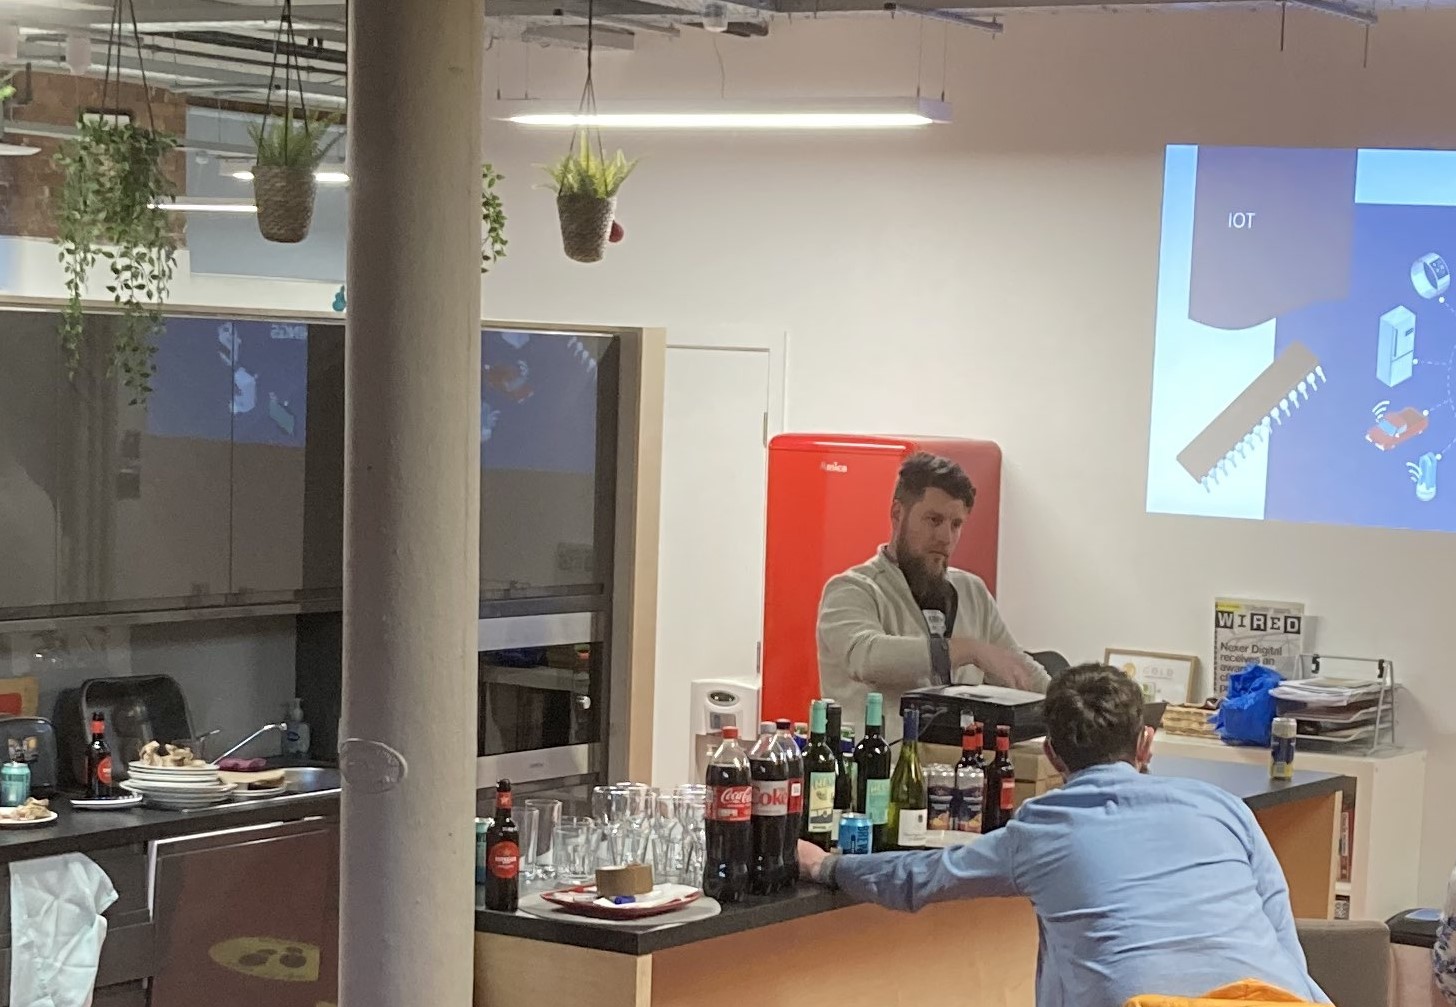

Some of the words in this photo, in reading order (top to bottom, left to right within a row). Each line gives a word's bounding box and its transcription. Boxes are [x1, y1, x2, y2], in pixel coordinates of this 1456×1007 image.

[1228, 212, 1256, 229] IOT
[1216, 611, 1302, 635] WIRED
[1251, 644, 1283, 657] Digital
[1262, 657, 1275, 666] an
